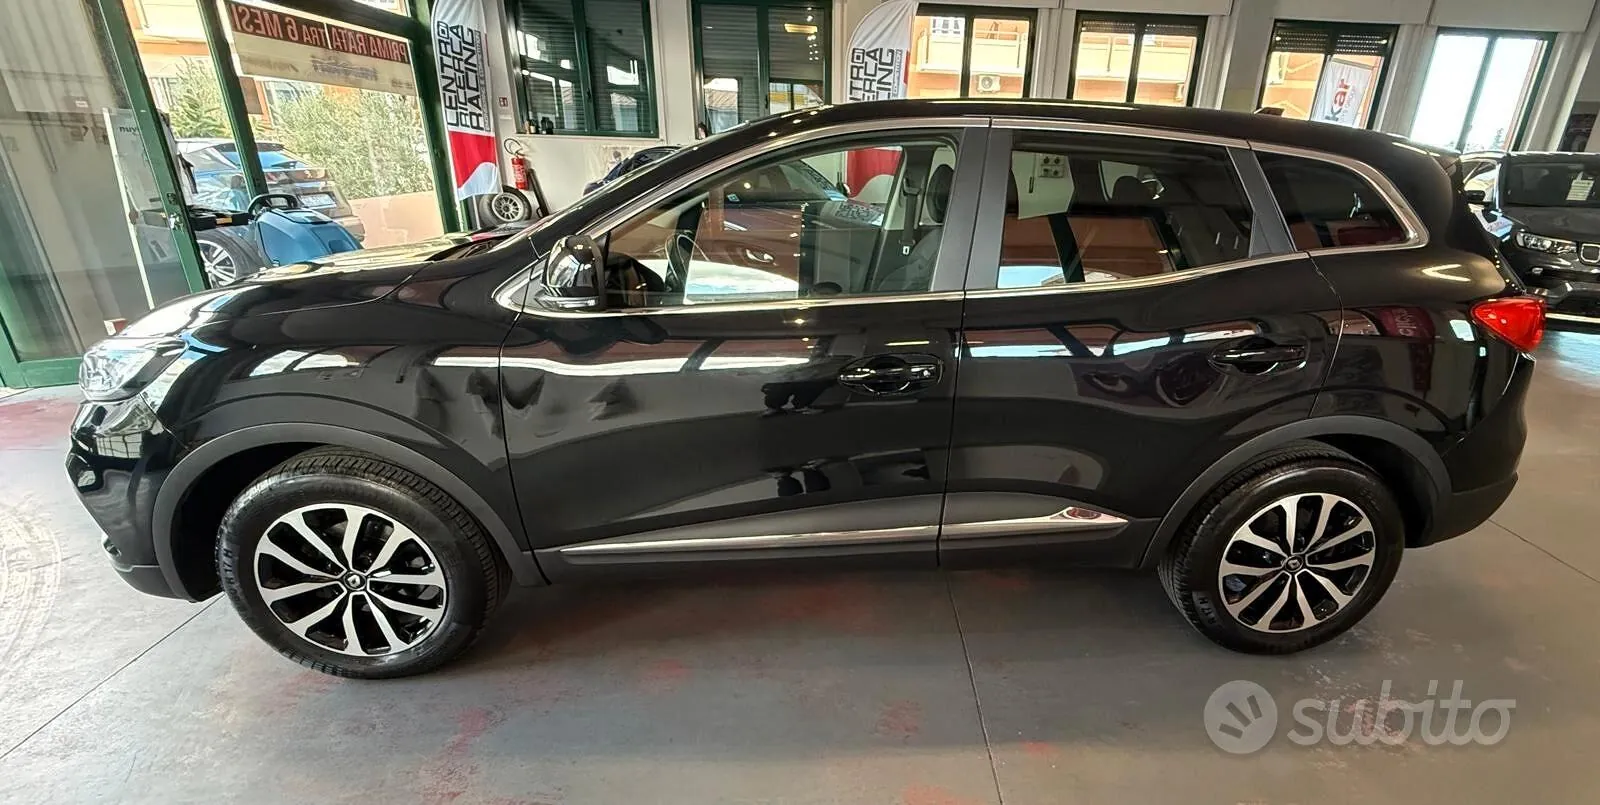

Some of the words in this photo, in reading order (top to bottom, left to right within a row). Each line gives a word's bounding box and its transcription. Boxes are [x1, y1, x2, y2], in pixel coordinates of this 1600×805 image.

[437, 20, 459, 127] CENTRO
[450, 24, 471, 128] RICERCA
[462, 27, 485, 131] RACING
